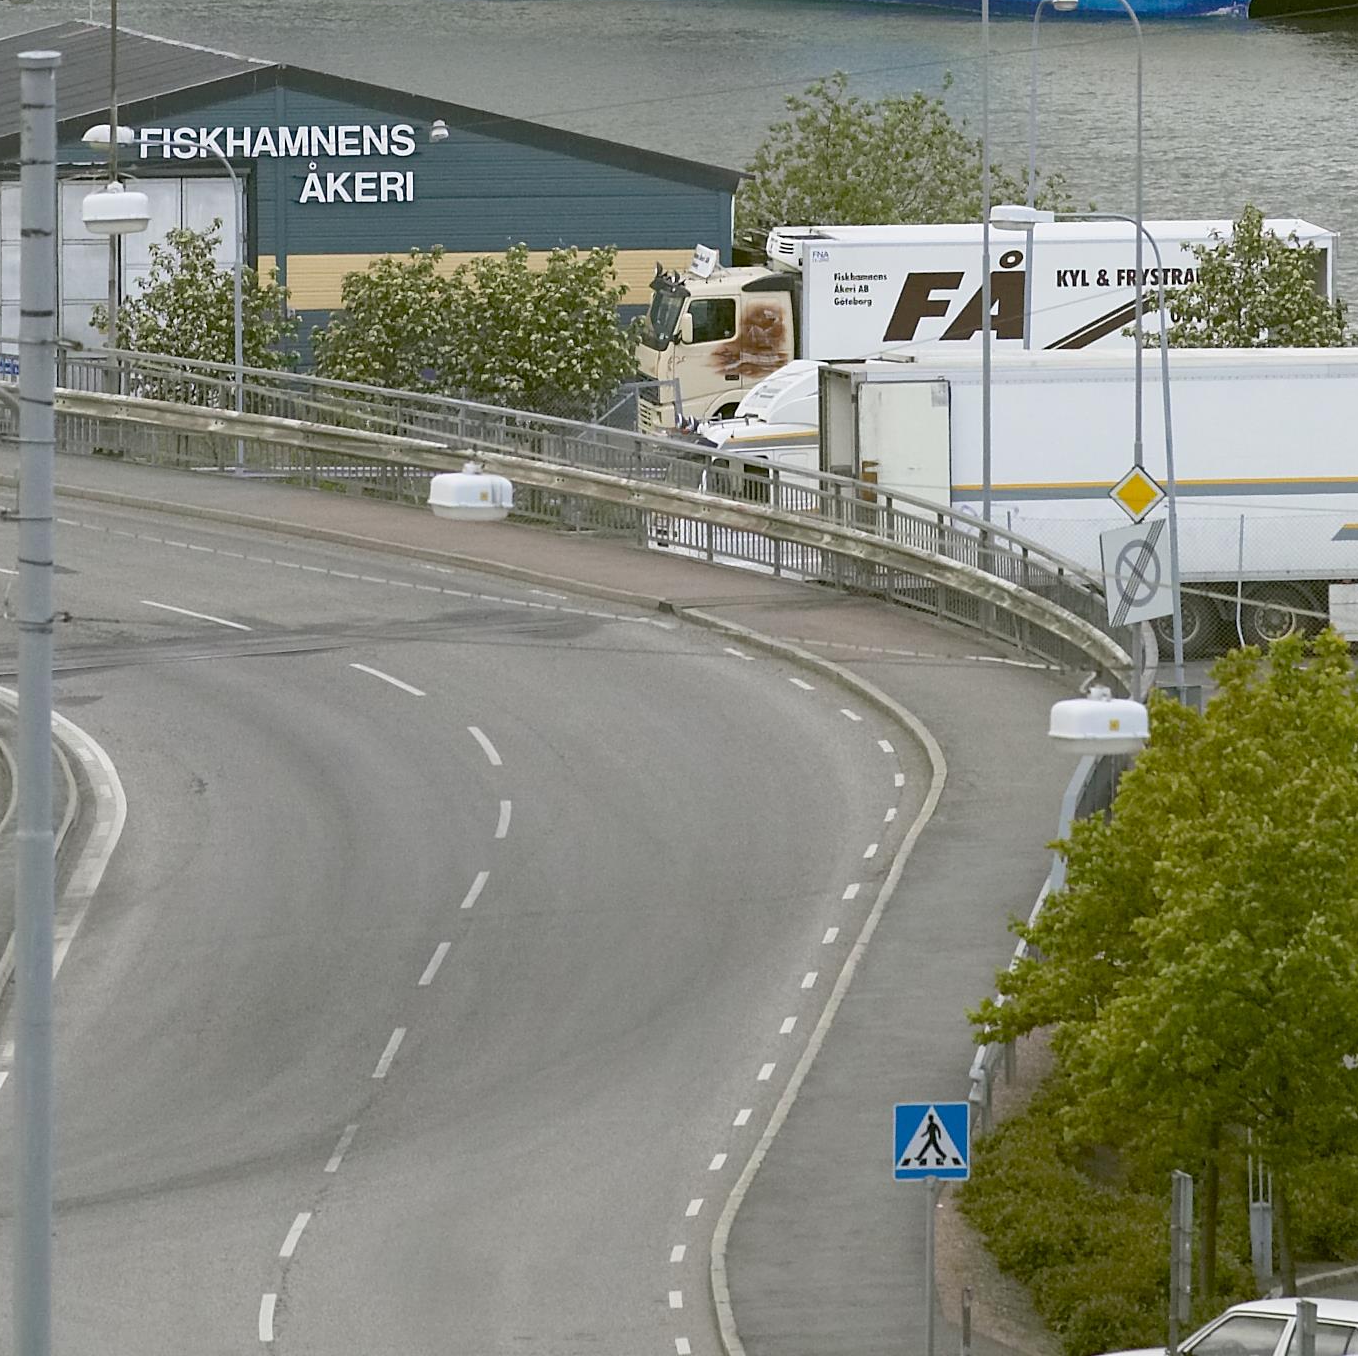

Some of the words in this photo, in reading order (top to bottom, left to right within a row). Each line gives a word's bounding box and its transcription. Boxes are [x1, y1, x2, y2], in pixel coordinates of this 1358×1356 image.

[139, 123, 416, 159] FISKHAMNENS
[299, 160, 414, 203] ÅKERI
[834, 272, 888, 281] Fiskhamnens
[1056, 269, 1090, 287] KYL
[1096, 268, 1110, 286] &
[834, 283, 856, 293] Åkeri
[858, 284, 869, 293] AB
[882, 250, 1026, 342] FÅ
[834, 296, 873, 307] Göteborg
